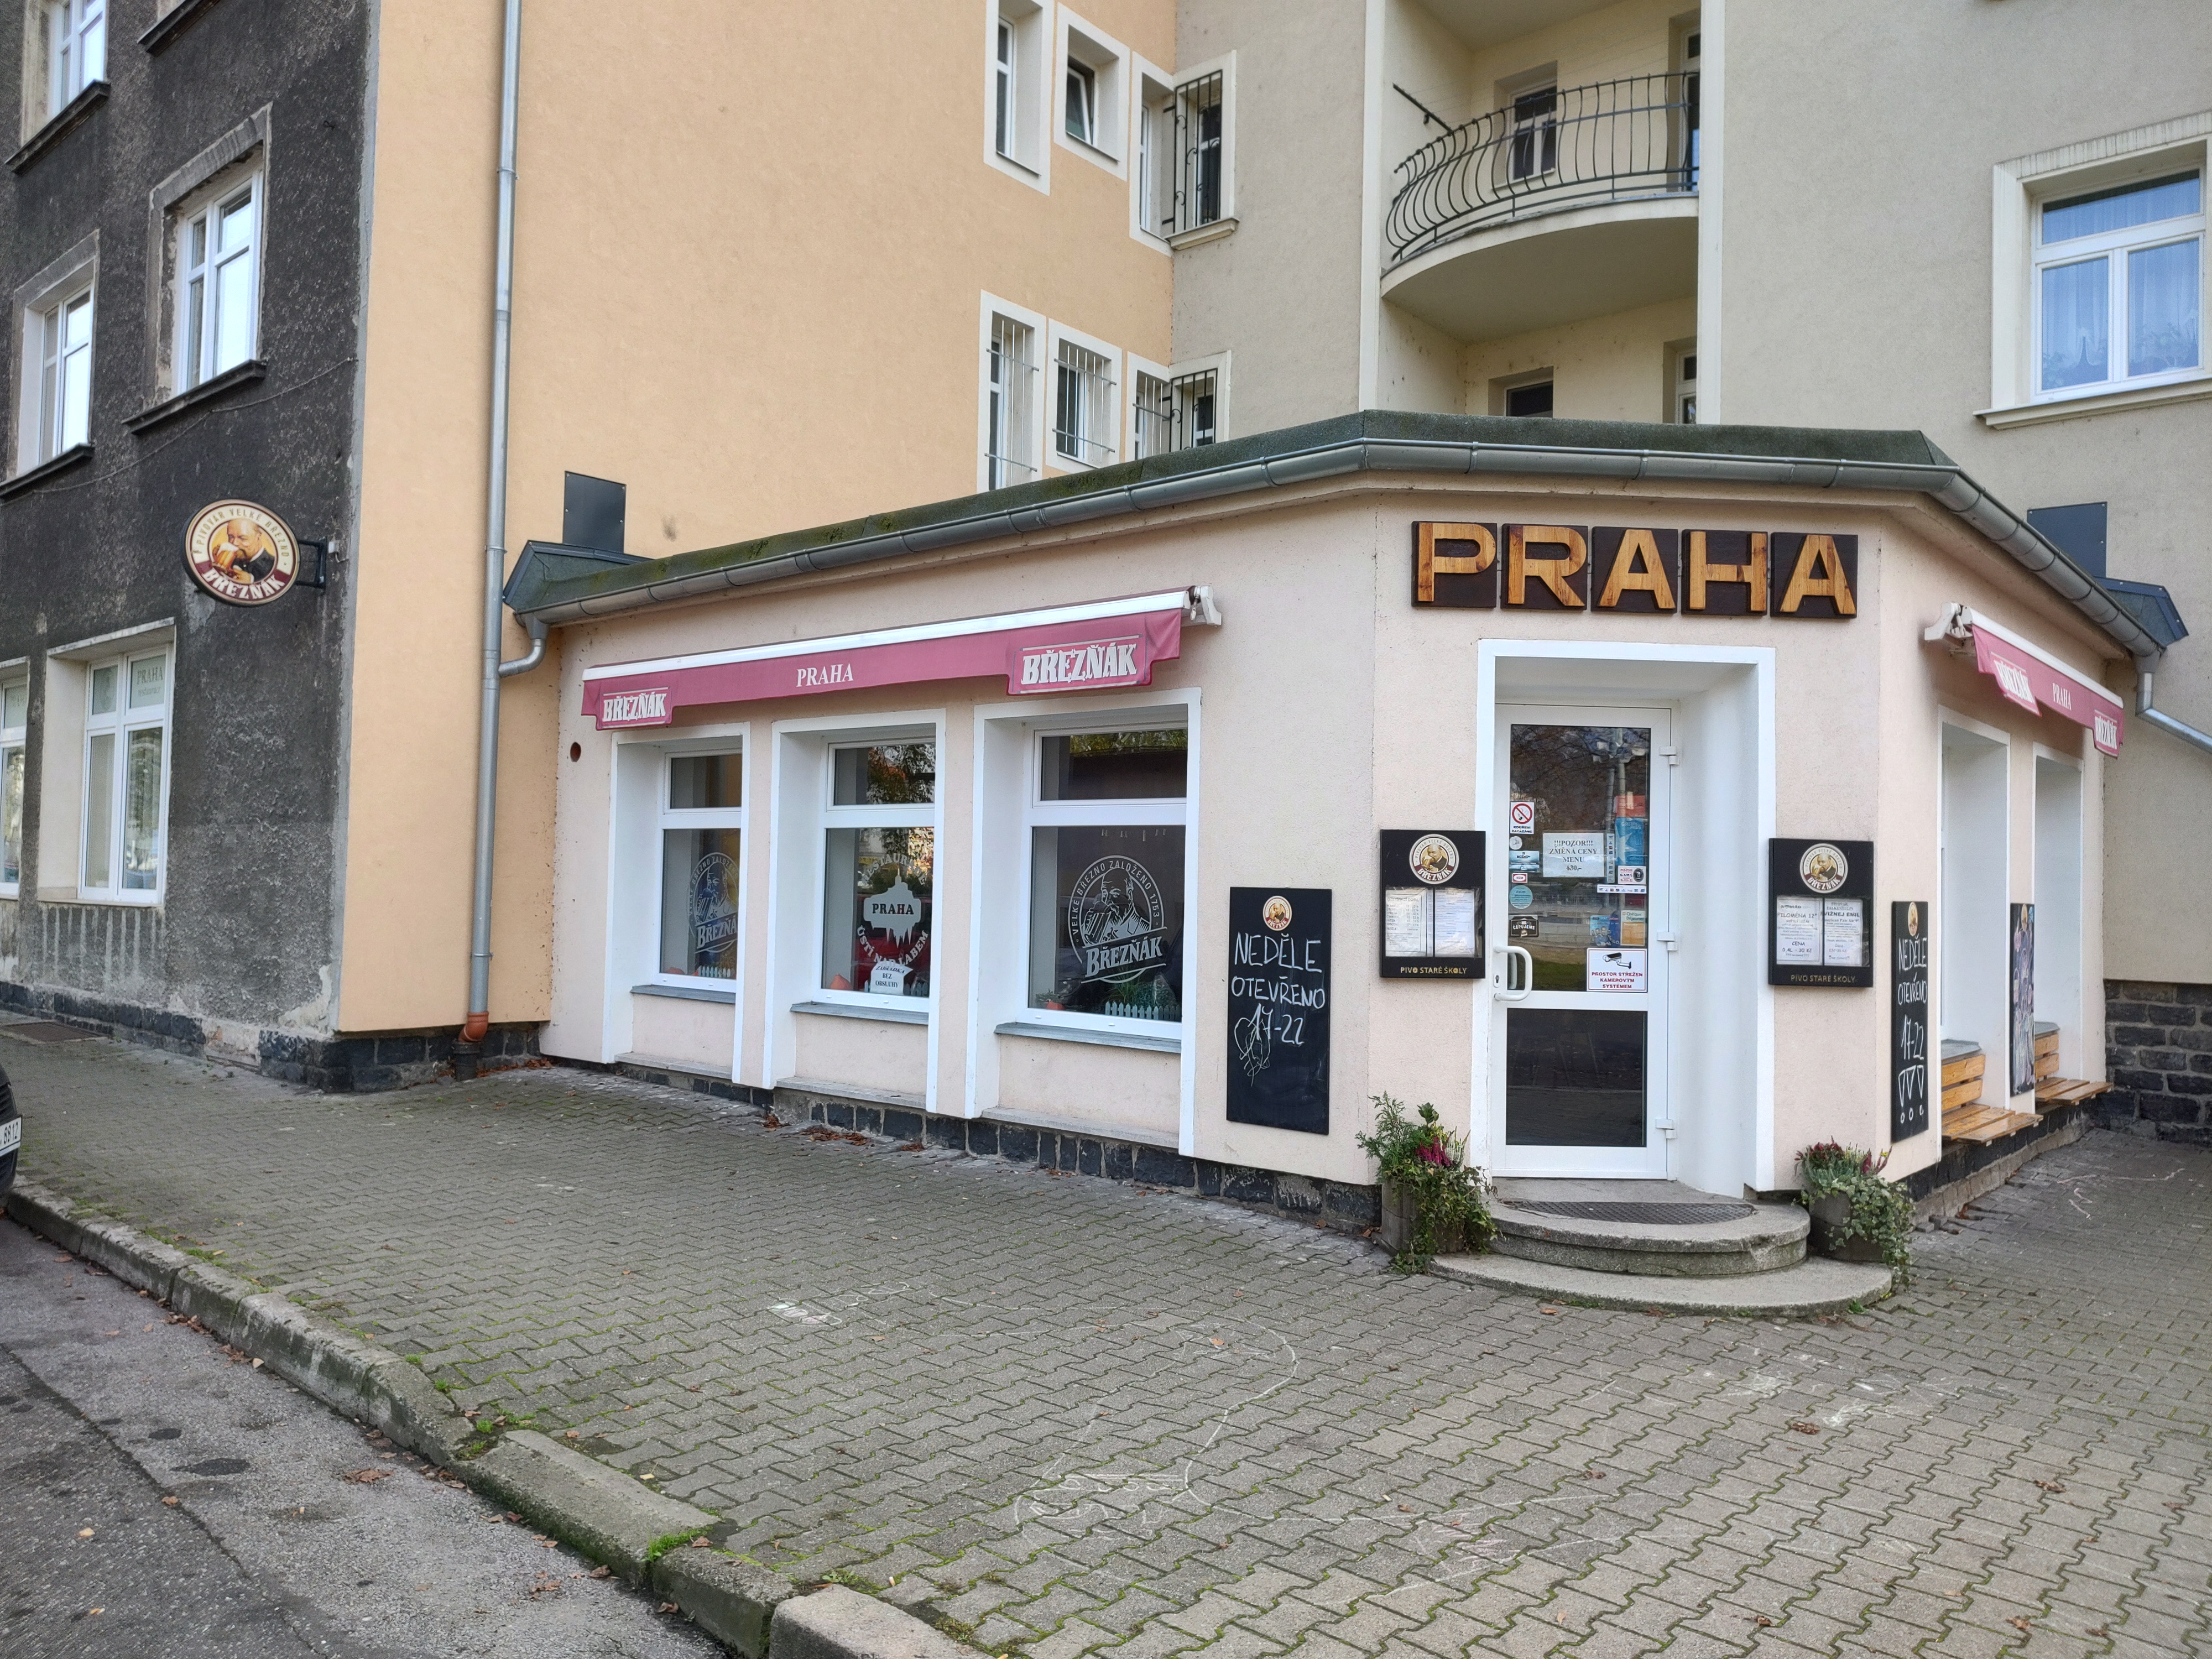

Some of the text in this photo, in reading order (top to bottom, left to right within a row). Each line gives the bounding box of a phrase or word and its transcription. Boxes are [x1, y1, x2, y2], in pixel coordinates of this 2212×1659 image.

[196, 512, 226, 545] PIVOVAR
[229, 508, 262, 521] VELKÉ
[1417, 523, 1857, 615] PRAHA
[137, 666, 163, 684] PRAHA
[796, 663, 853, 687] PRAHA
[1021, 643, 1138, 685] BŘEZŇÁK
[602, 692, 666, 722] BŘEZŇÁK
[2053, 683, 2072, 711] PRAHA
[1077, 863, 1105, 896] BŘEZNO
[1109, 860, 1151, 890] ZALOŽENO
[1150, 894, 1160, 917] 1753
[872, 903, 914, 915] PRAHA
[898, 930, 928, 966] LABEM
[1085, 936, 1162, 977] BŘEZŇÁK
[1235, 932, 1322, 972] NEDĚLE
[1898, 932, 1927, 974] NEDĚLE
[1444, 966, 1467, 974] ŠKOLY
[1232, 975, 1325, 1009] OTEVŘENO
[1898, 972, 1927, 1005] OTEVŘENO
[4, 1121, 18, 1144] 8812
